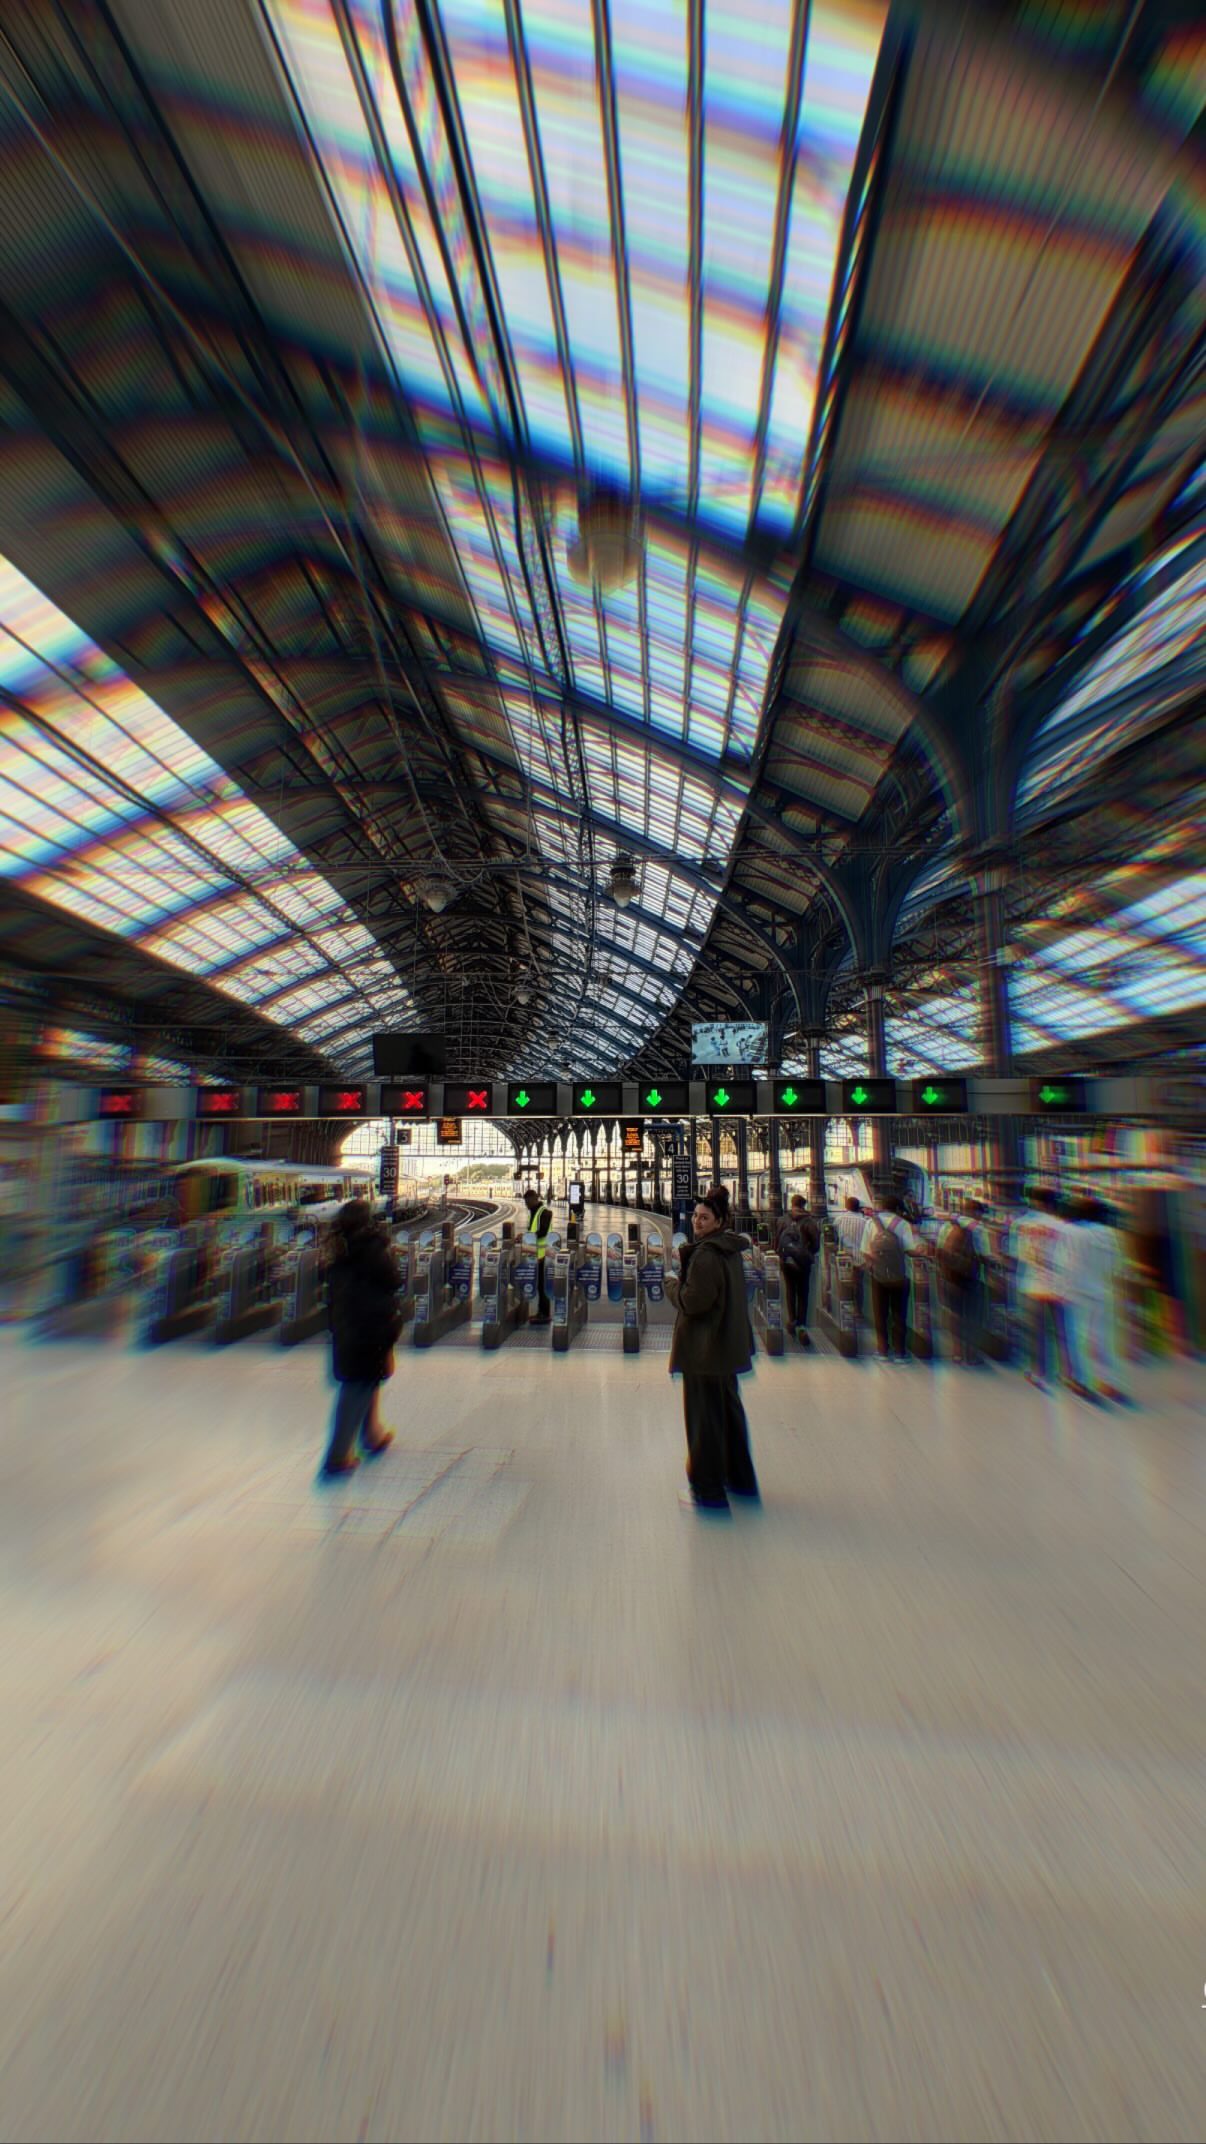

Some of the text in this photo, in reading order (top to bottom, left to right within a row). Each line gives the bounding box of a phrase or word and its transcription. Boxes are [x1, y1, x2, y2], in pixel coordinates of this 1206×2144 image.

[400, 1130, 408, 1142] 3
[668, 1143, 675, 1153] 4
[383, 1167, 397, 1177] 30
[676, 1174, 689, 1184] 30
